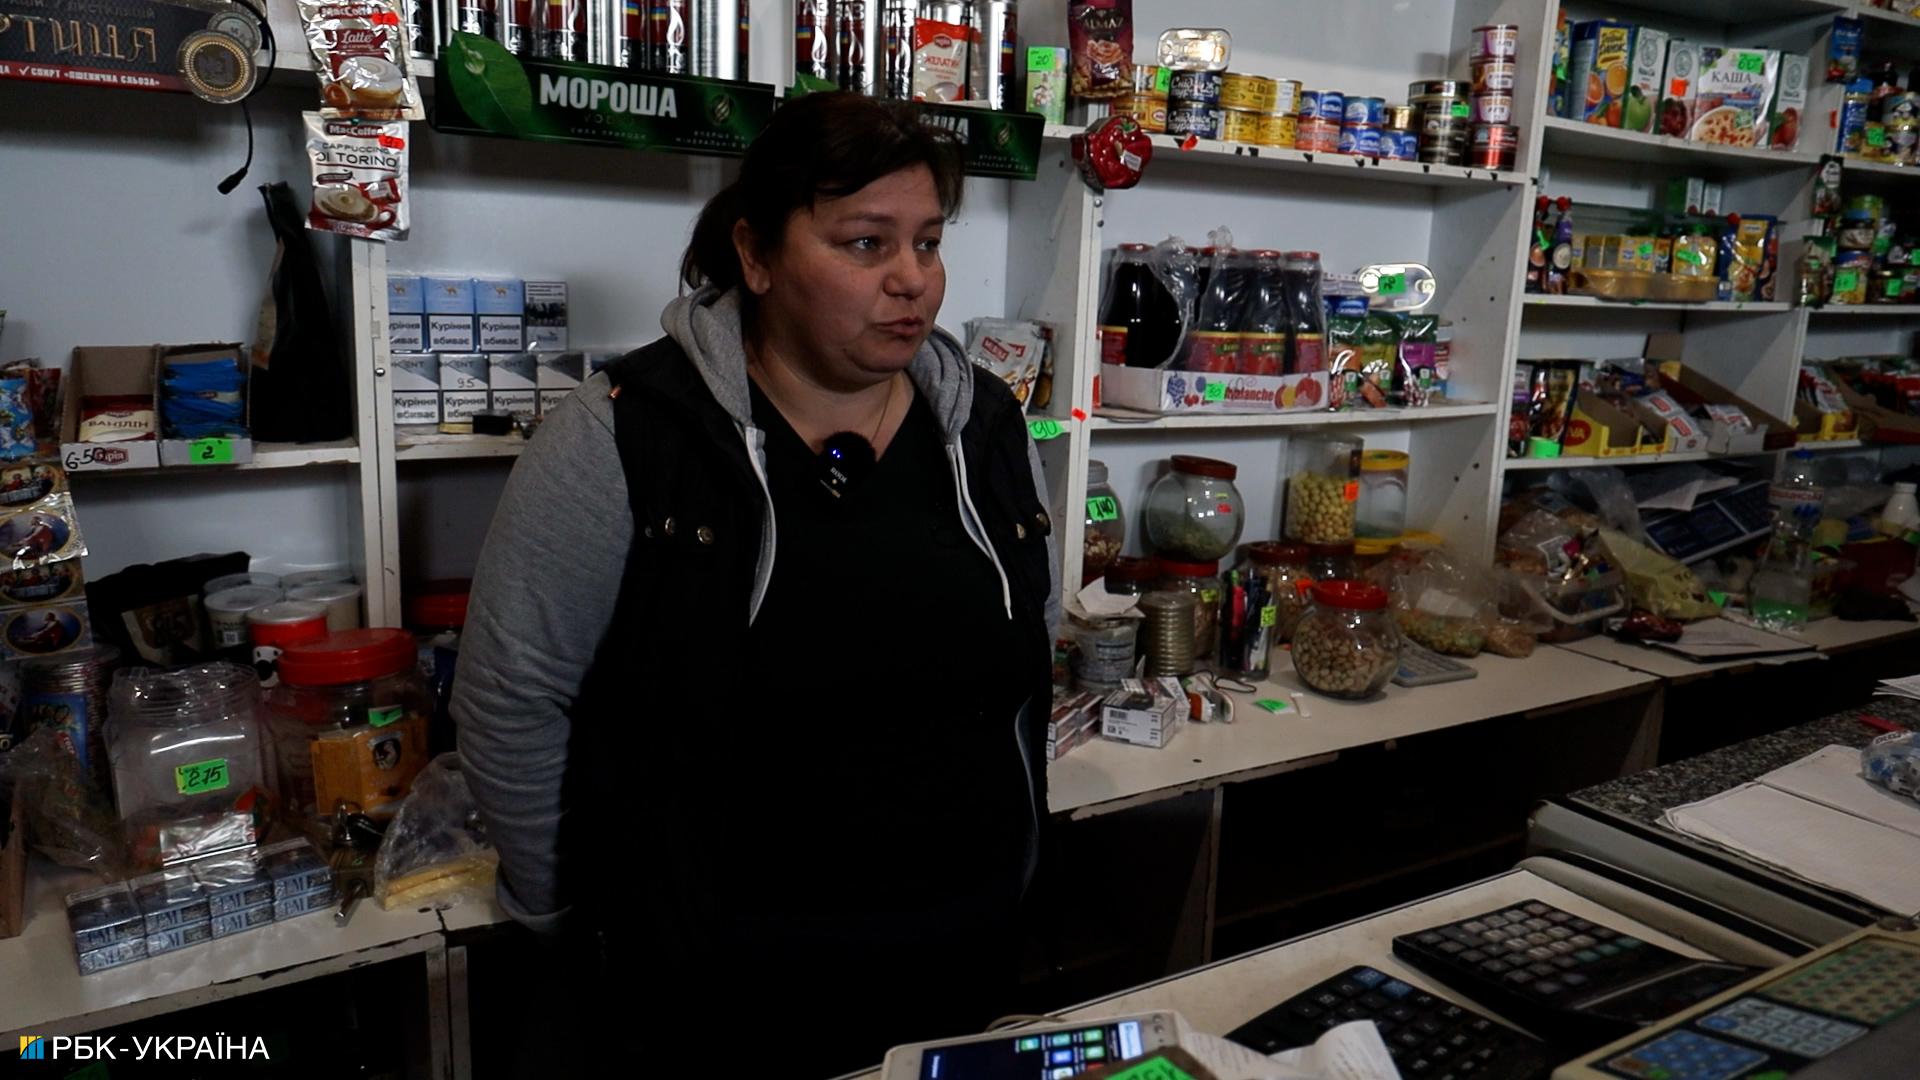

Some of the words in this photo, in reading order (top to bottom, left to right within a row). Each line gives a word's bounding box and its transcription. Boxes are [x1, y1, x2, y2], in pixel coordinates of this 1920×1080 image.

[341, 30, 375, 44] Latte
[1711, 72, 1752, 83] КАША
[539, 72, 680, 119] МОРОША
[336, 153, 399, 168] TORINO
[431, 321, 471, 335] Куріння
[481, 321, 521, 335] Куріння
[457, 377, 476, 389] 95
[395, 396, 437, 409] Куріння
[445, 396, 487, 409] Куріння
[89, 420, 149, 429] ВАНІЛІН
[202, 445, 216, 460] 2
